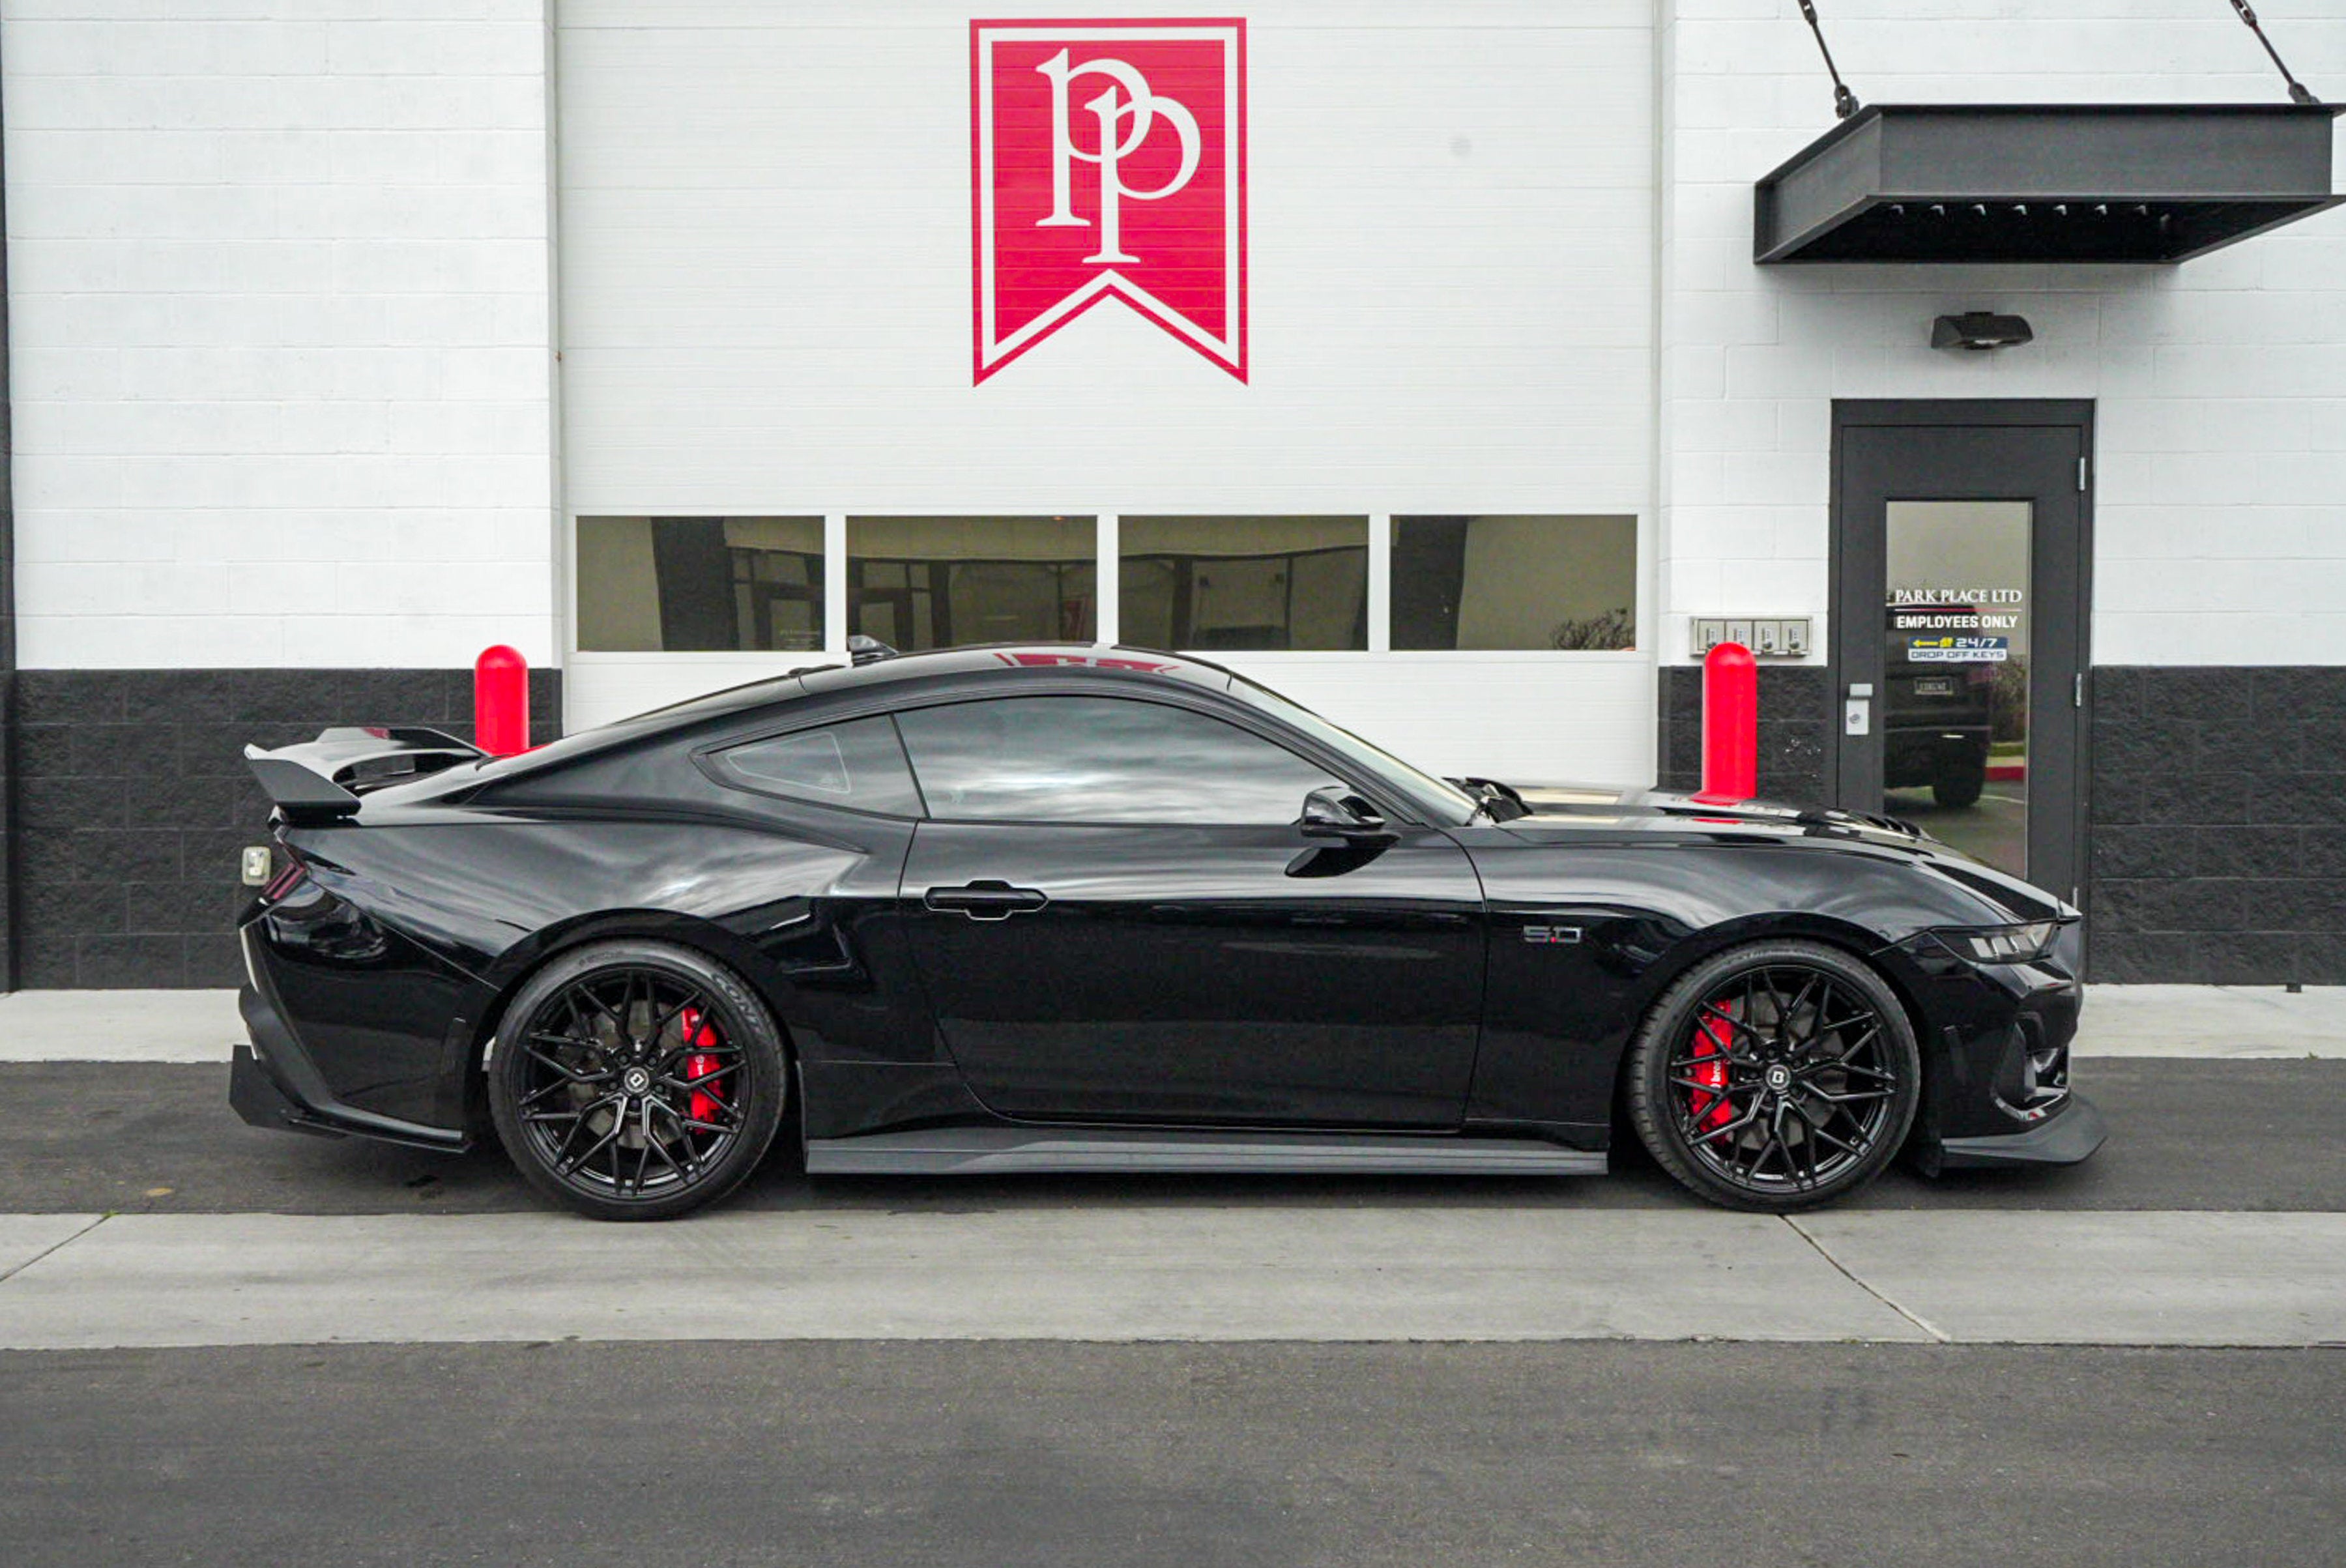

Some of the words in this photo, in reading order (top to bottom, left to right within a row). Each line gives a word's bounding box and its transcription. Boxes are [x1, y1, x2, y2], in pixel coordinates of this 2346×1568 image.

[1895, 589, 1937, 603] PARK
[1941, 589, 1987, 603] PLACE
[1991, 589, 2023, 603] LTD
[1896, 616, 1979, 629] EMPLOYEES
[1982, 616, 2018, 628] ONLY
[1956, 637, 1998, 648] 24/7
